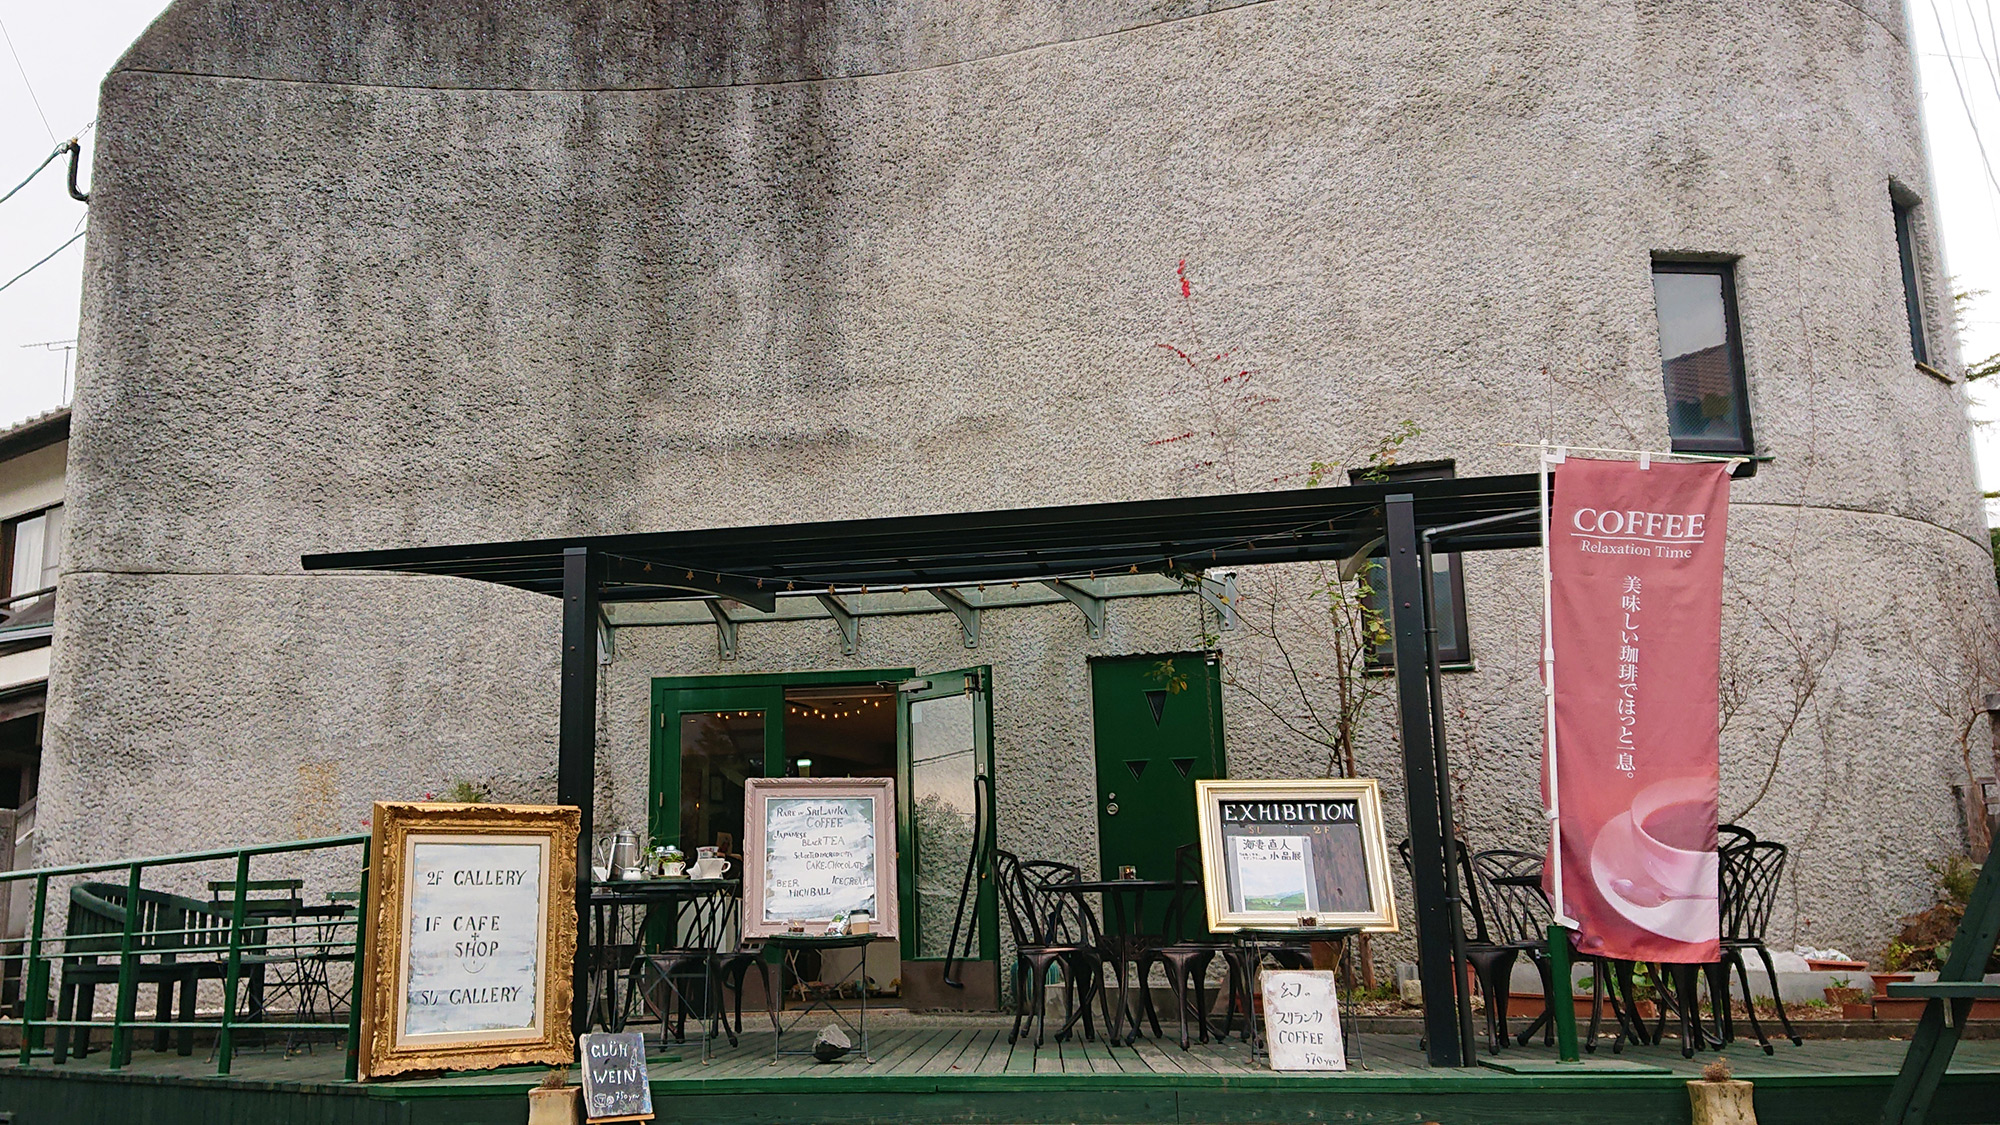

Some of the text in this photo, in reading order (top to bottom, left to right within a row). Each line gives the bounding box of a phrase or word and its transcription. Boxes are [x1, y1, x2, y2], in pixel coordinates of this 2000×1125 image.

[1573, 508, 1706, 538] COFFEE
[1580, 539, 1692, 559] Relaxation Time
[1615, 575, 1643, 779] 美味しい珈琲でほっと一息。
[1224, 803, 1355, 821] EXHIBITION
[806, 817, 844, 828] COFFEE
[1313, 826, 1331, 834] 2F
[426, 870, 528, 886] 2F GALLERY
[776, 878, 800, 888] BEER
[425, 915, 500, 931] 1F CAFE
[454, 941, 499, 957] SHOP
[449, 985, 523, 1005] GALLERY
[1275, 1009, 1323, 1025] スリランカ
[1278, 1030, 1324, 1045] COFFEE
[591, 1040, 628, 1057] GLÜH
[593, 1069, 637, 1085] WEIN
